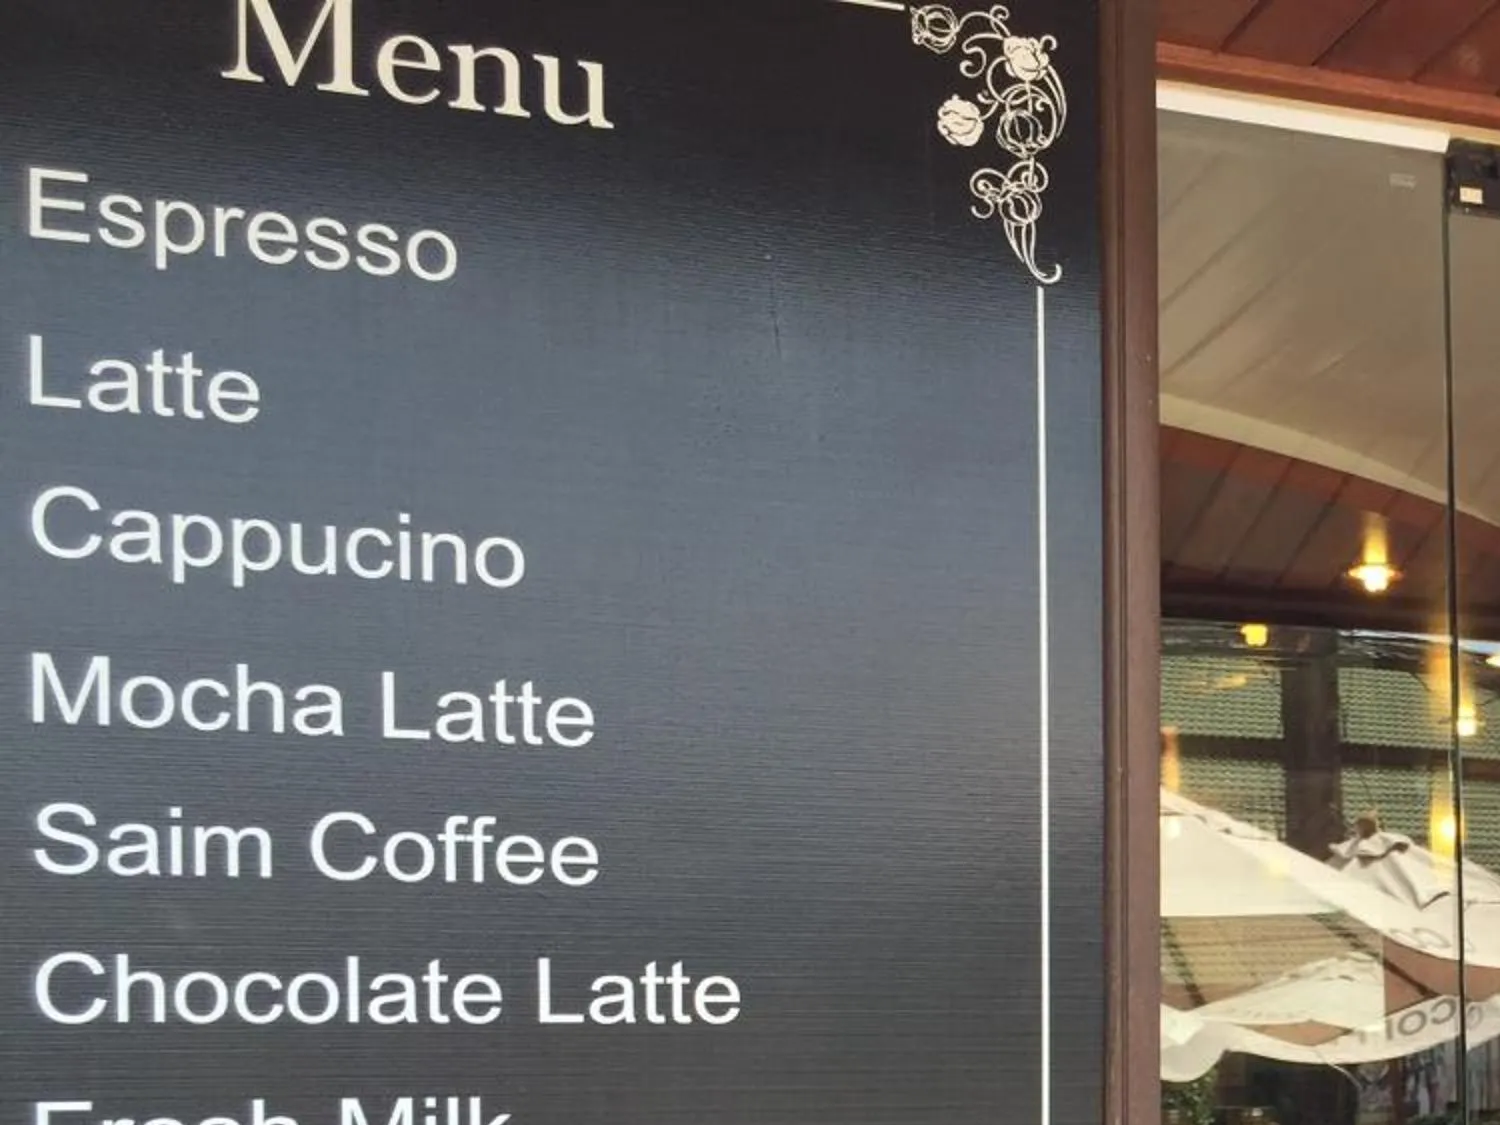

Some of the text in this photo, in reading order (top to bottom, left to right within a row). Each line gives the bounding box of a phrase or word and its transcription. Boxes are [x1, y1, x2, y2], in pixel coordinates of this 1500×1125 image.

[221, 0, 614, 129] Menu
[28, 166, 458, 283] Espresso
[28, 333, 261, 425] Latte
[29, 484, 526, 589] Cappucino
[30, 650, 596, 749] Mocha Latte
[32, 801, 600, 887] Saim Coffee
[34, 950, 742, 1026] Chocolate Latte
